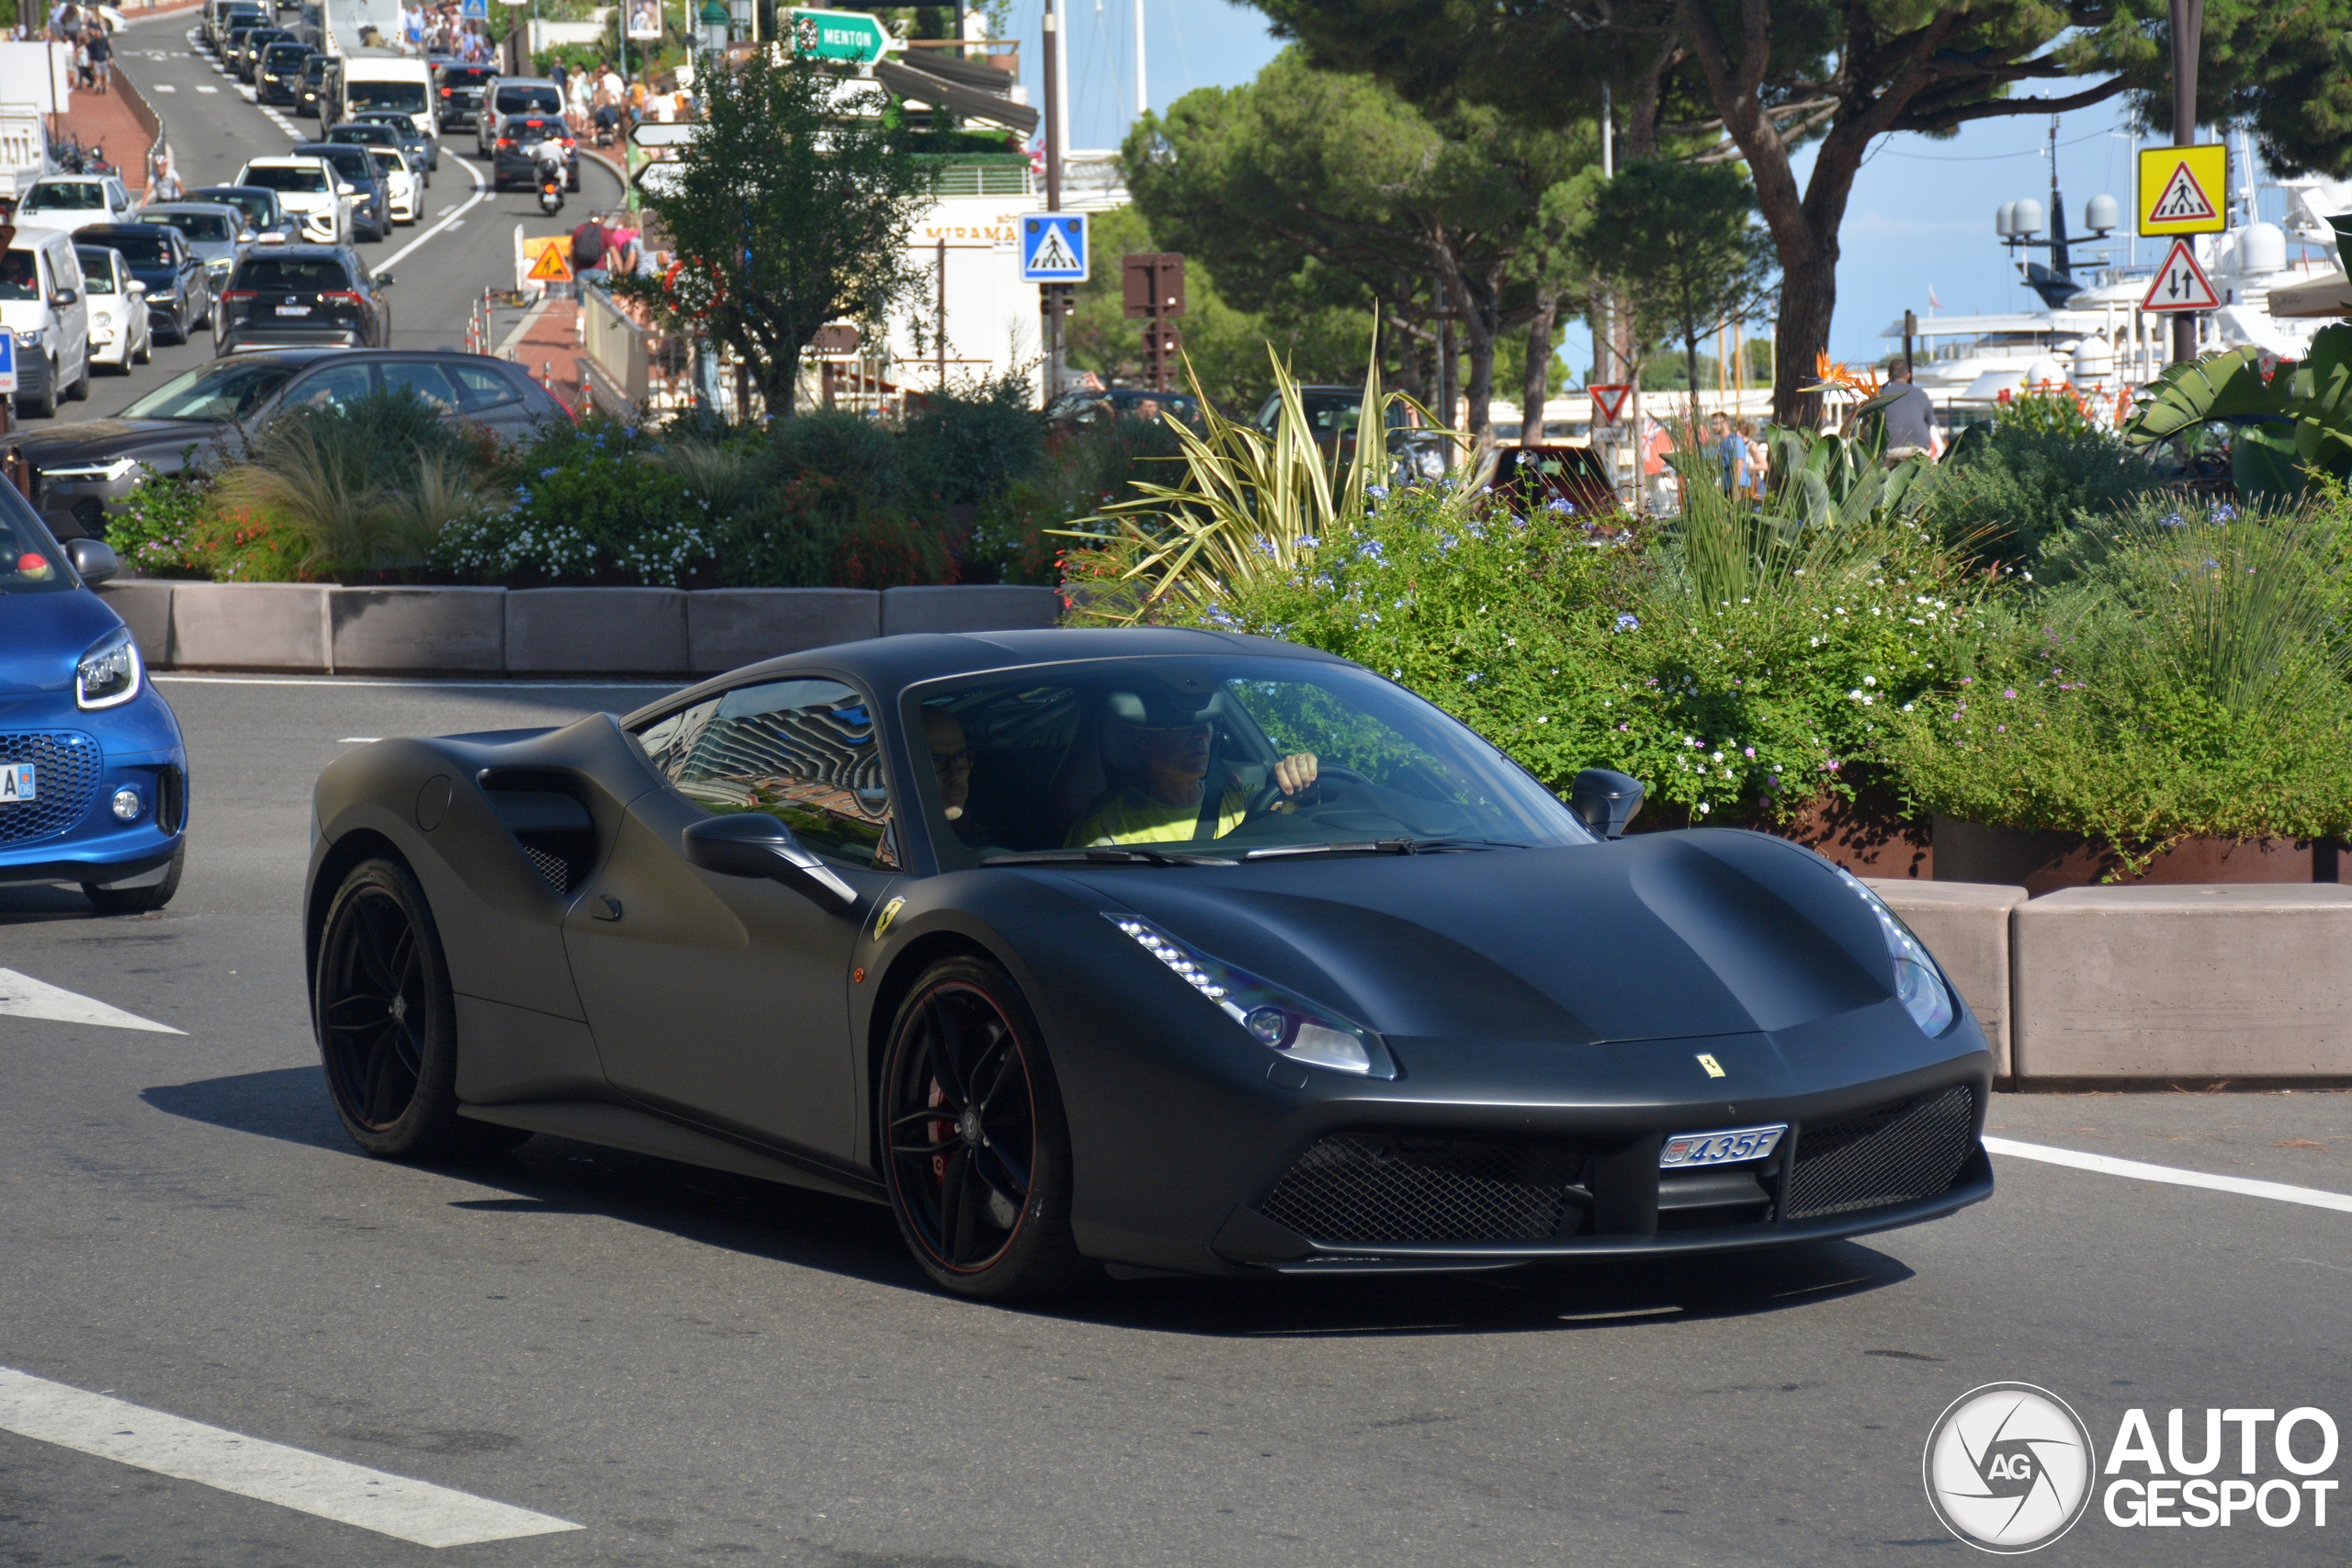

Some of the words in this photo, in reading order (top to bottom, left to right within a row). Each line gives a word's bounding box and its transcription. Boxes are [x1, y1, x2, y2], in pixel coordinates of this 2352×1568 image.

[823, 28, 872, 47] MENTON
[996, 213, 1020, 224] HÔT
[925, 226, 1018, 241] MIRAMA
[19, 784, 32, 796] 06
[1667, 1152, 1687, 1160] MC
[1689, 1130, 1781, 1161] 435F
